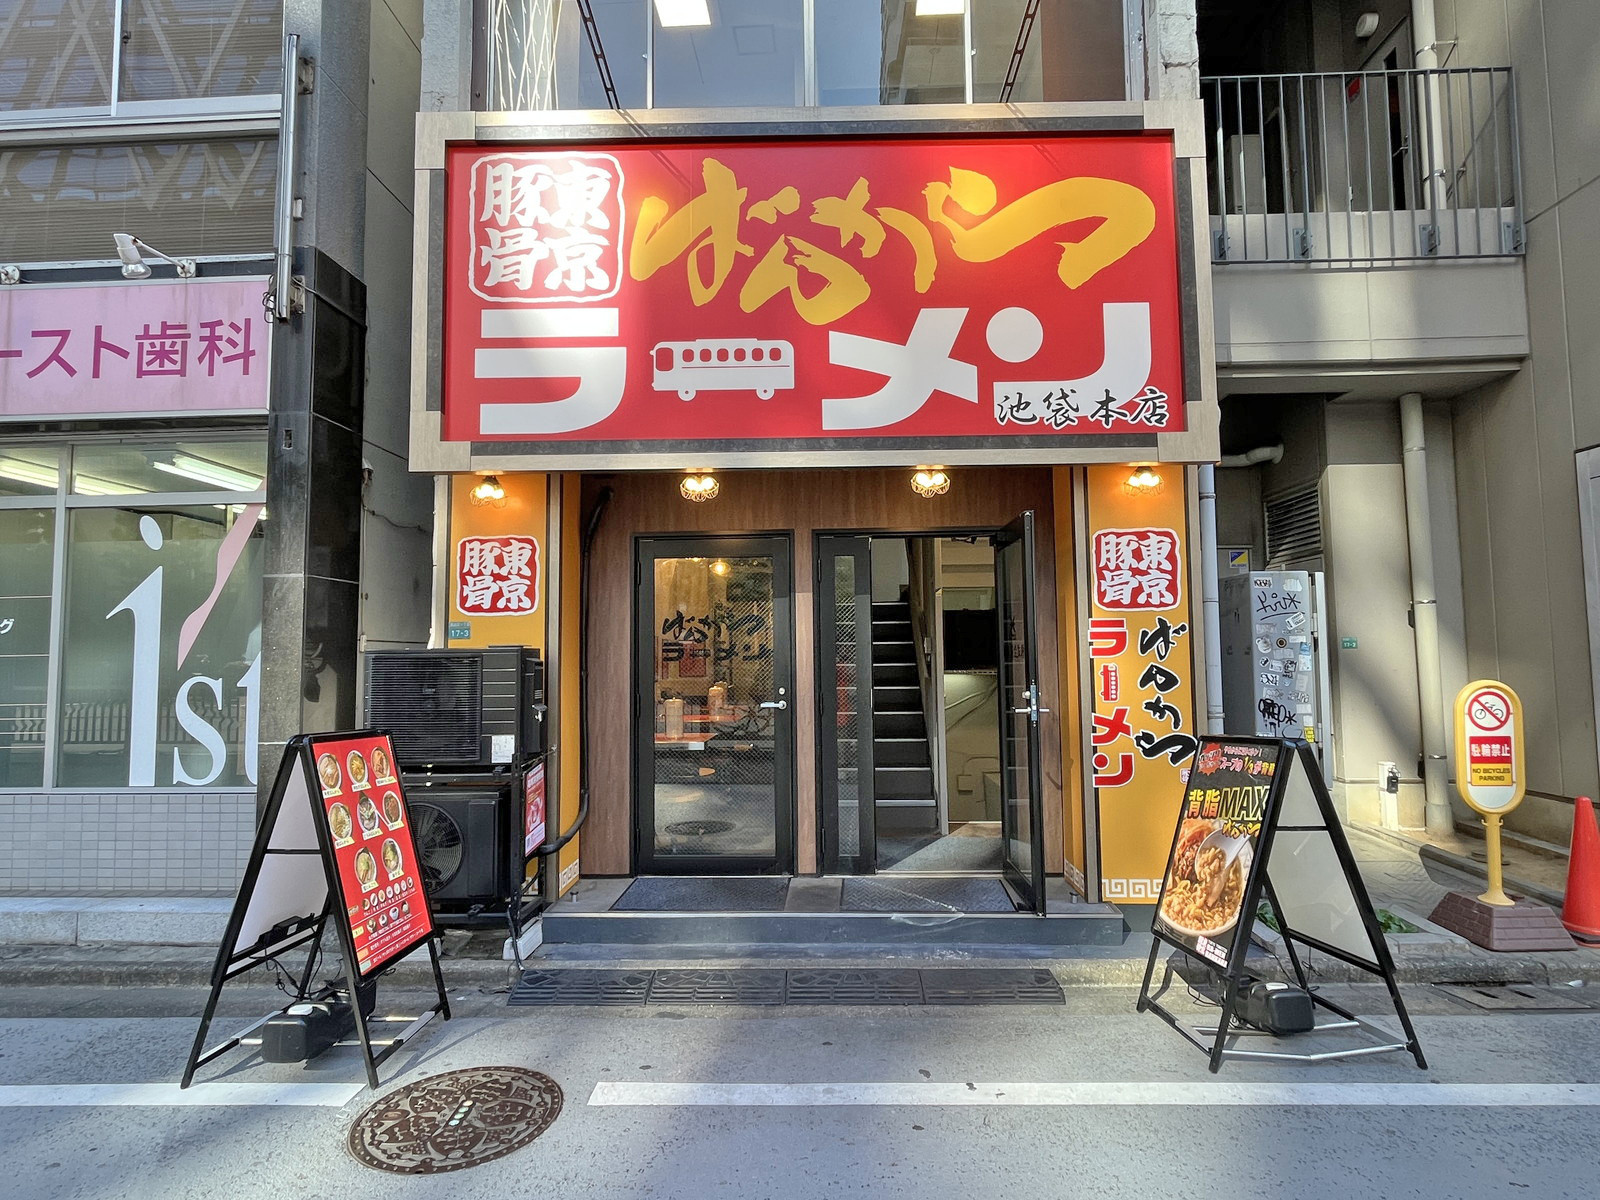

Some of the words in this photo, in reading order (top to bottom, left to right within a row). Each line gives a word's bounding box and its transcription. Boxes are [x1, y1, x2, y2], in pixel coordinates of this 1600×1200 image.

[629, 157, 1156, 326] ばんから
[474, 301, 1152, 435] ラーメン
[997, 386, 1171, 429] 池袋本店
[451, 629, 470, 637] 17-3
[1090, 618, 1135, 787] ラーメン
[1471, 743, 1510, 757] 駐輪禁止
